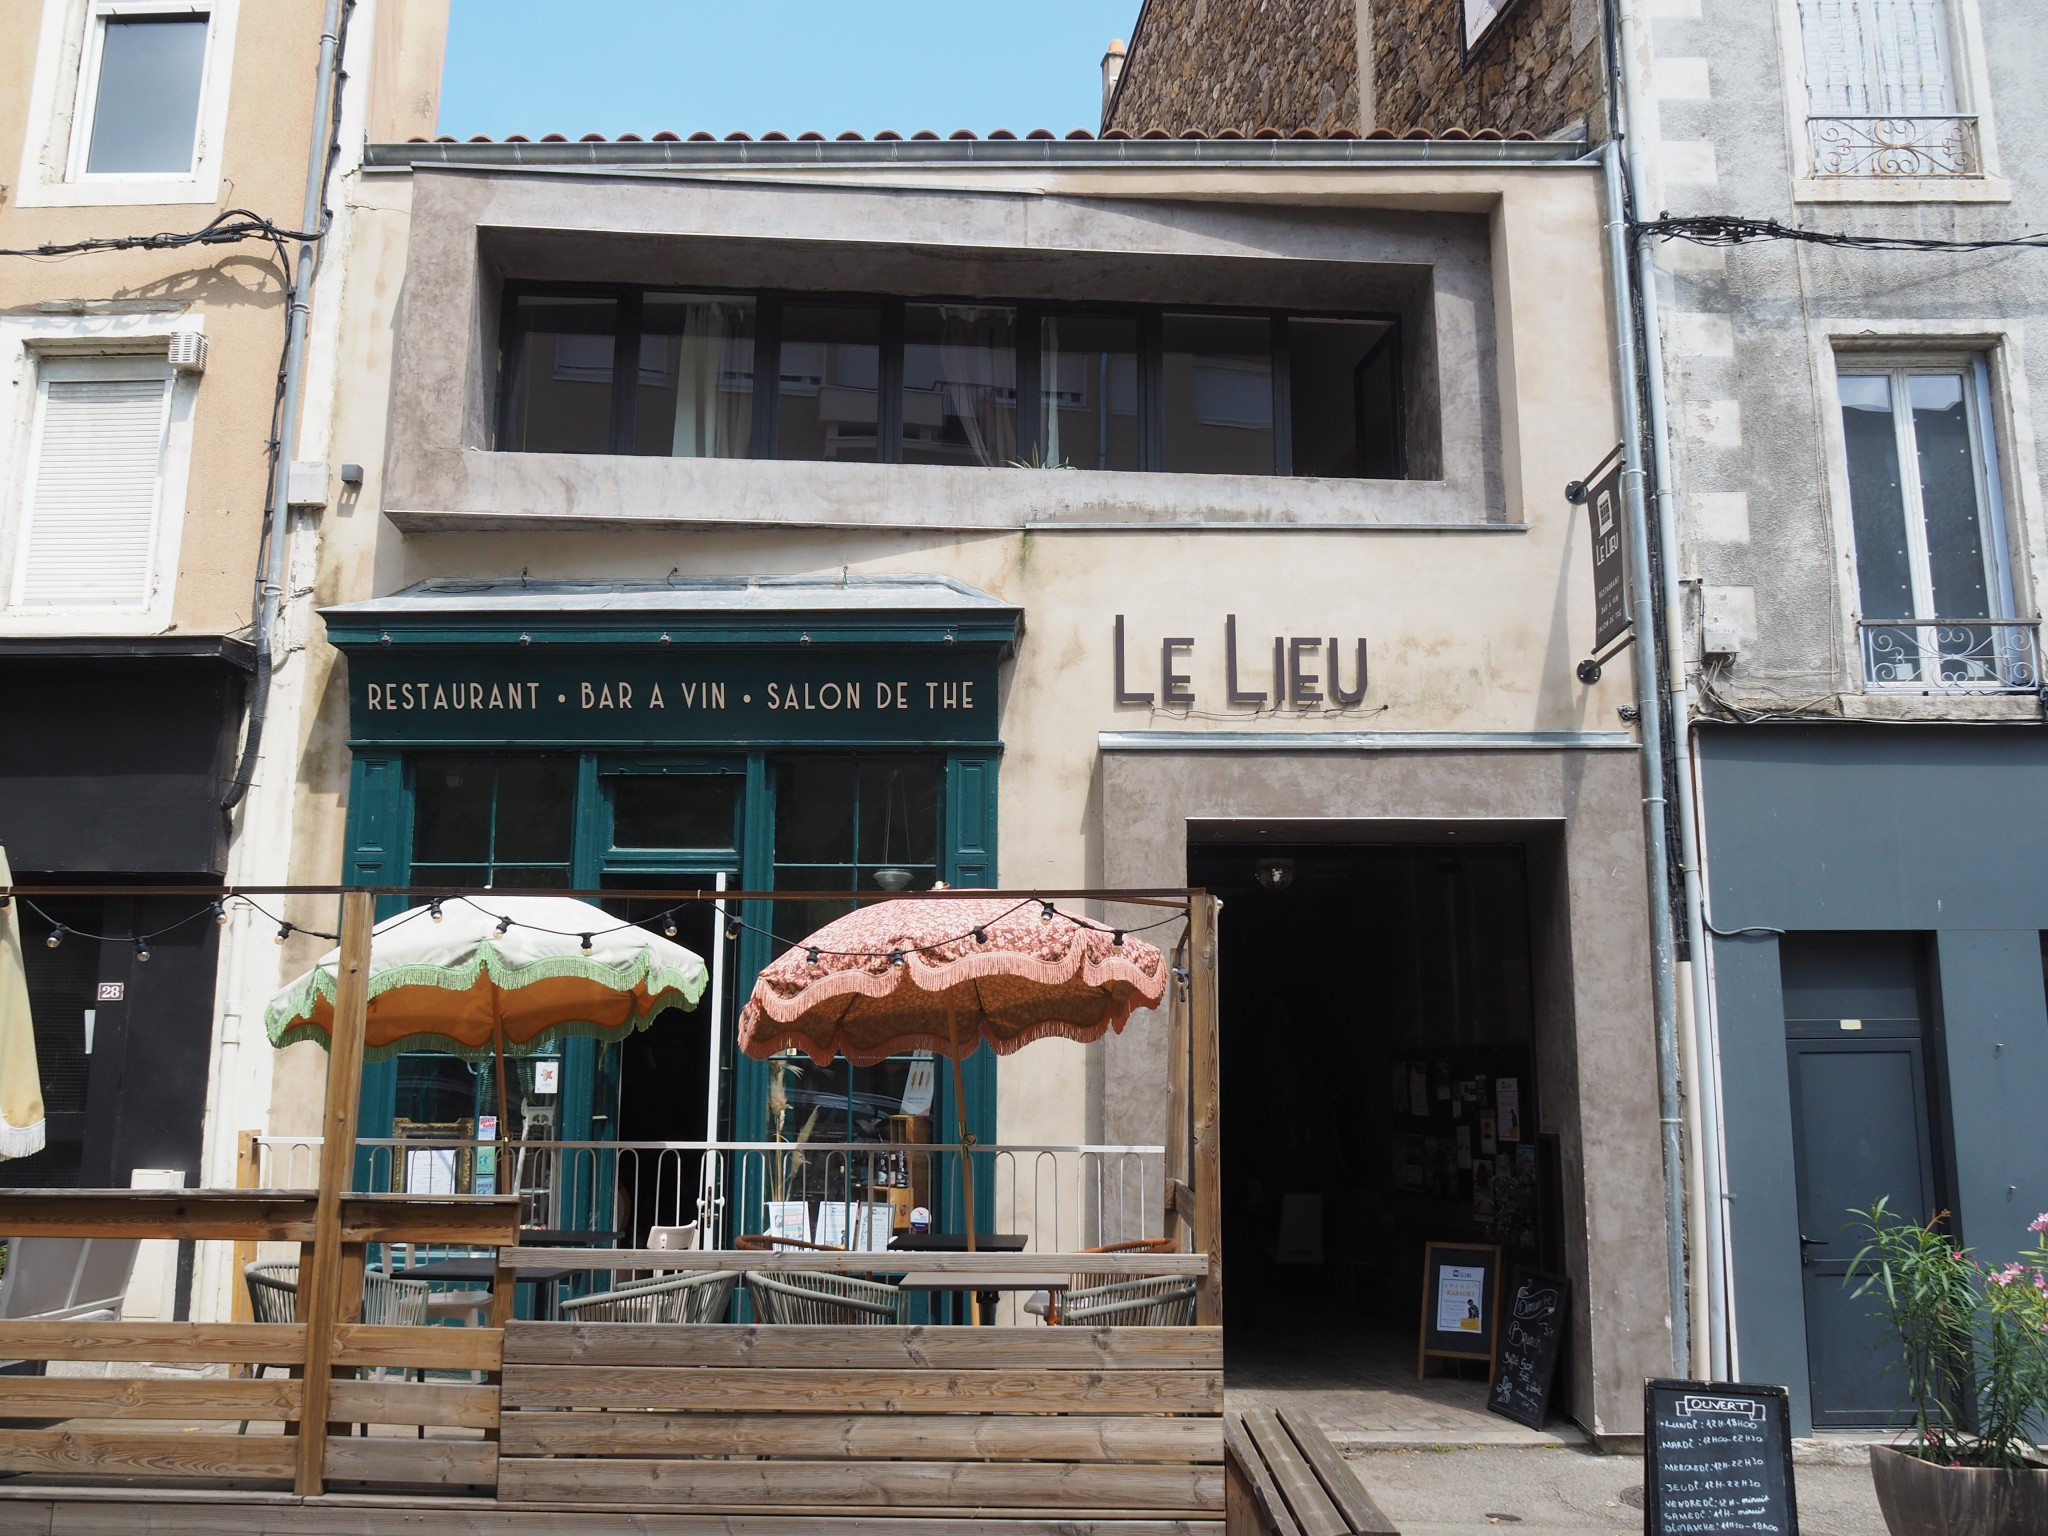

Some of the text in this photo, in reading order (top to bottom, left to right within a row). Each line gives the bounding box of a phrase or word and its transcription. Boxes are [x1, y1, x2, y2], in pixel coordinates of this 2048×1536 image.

[1598, 575, 1620, 599] RESTAURANT
[1115, 613, 1368, 703] LE LIEU
[367, 681, 974, 710] RESTAURANT BAR A VIN SALON DE THE
[101, 985, 120, 998] 28
[1690, 1399, 1750, 1411] OUVERT
